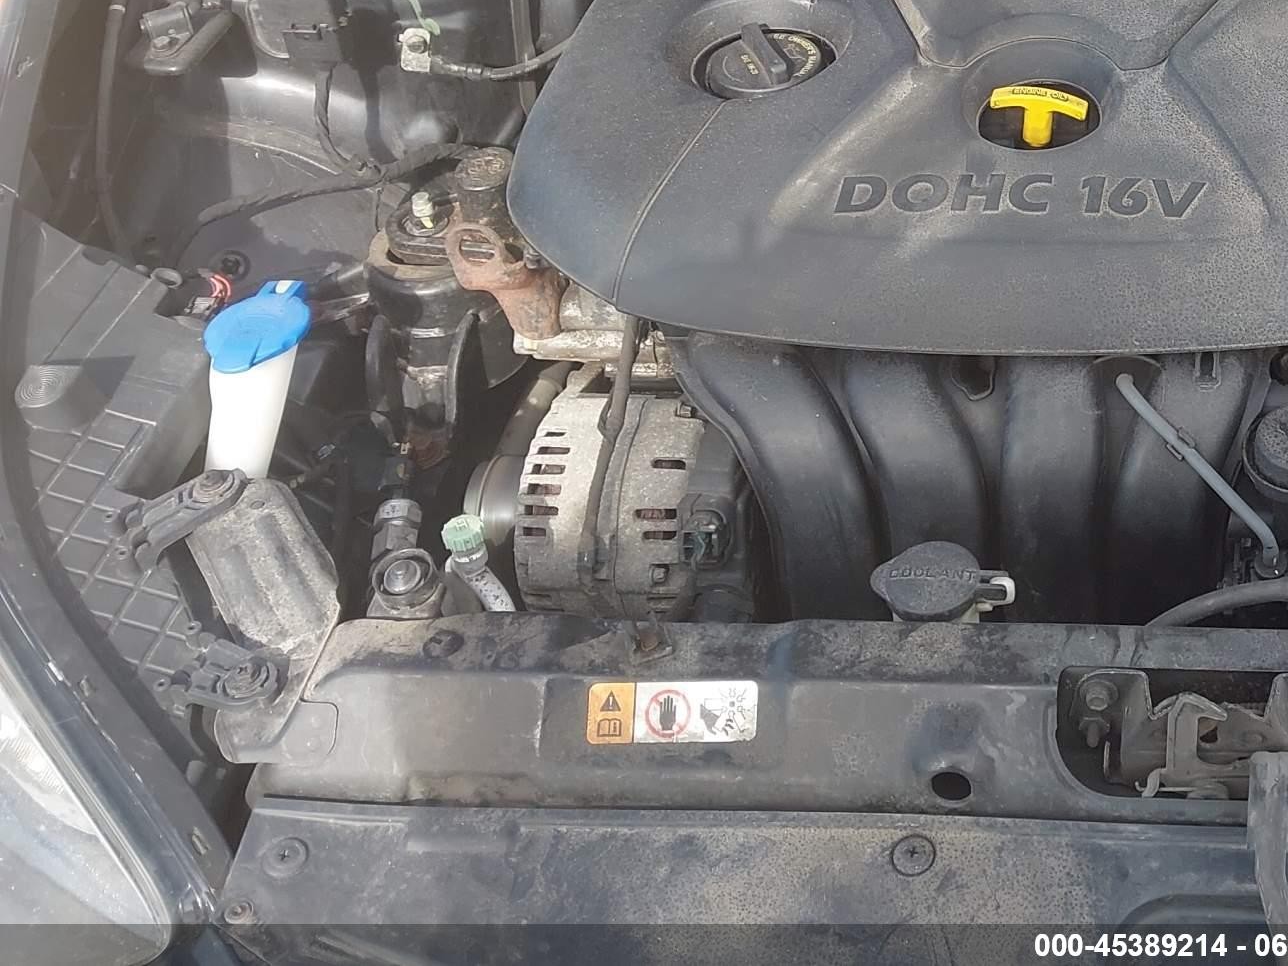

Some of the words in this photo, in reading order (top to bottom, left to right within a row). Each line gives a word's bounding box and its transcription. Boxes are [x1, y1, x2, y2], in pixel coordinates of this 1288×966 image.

[1012, 88, 1048, 97] ENGINE
[834, 173, 1053, 215] DOHC
[1080, 175, 1206, 218] 16V
[889, 568, 977, 583] COOLANT
